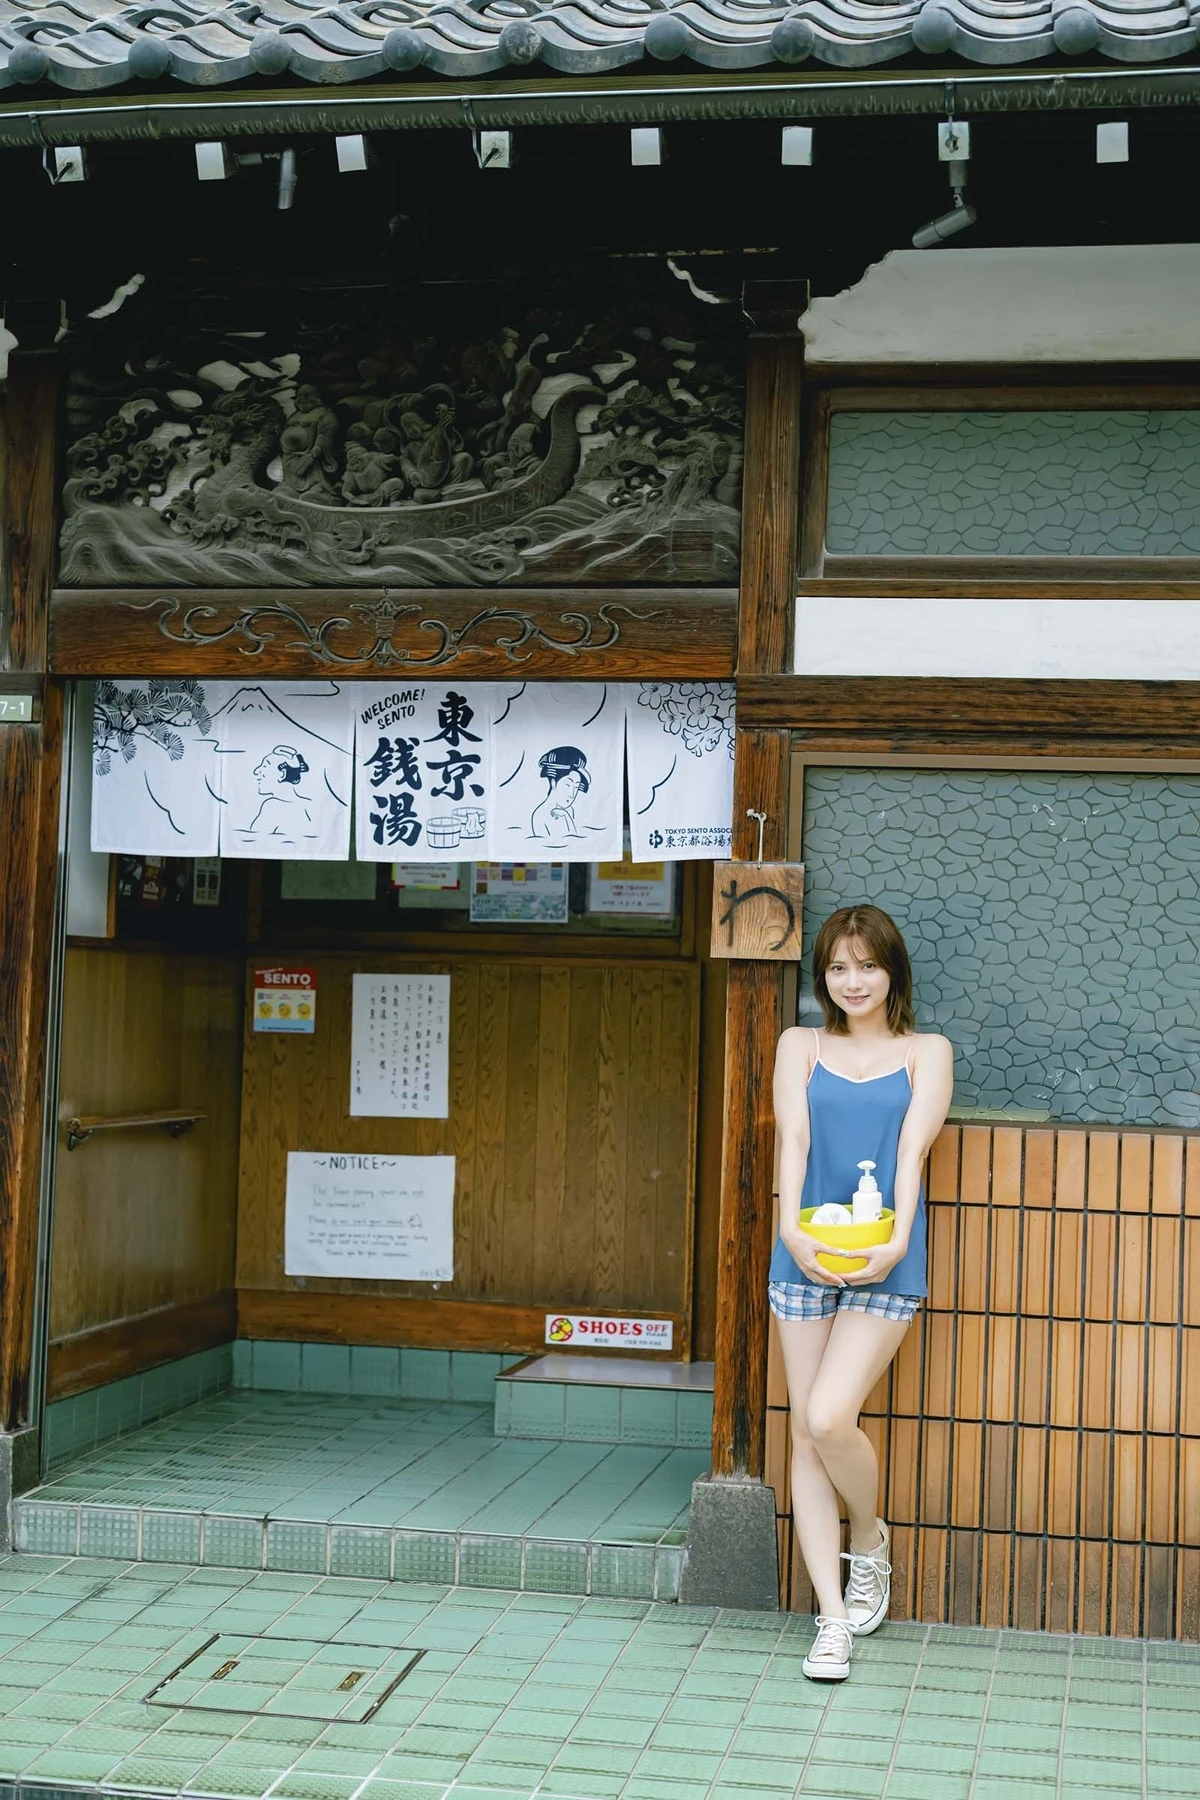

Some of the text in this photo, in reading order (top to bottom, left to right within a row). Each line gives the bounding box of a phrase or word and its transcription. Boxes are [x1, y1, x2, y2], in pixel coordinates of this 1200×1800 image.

[0, 700, 25, 716] 7-1
[361, 688, 426, 725] WELCOME!
[377, 704, 416, 730] SENTO
[423, 690, 485, 802] 東京
[363, 736, 423, 847] 銭湯
[719, 880, 795, 952] わ
[263, 972, 312, 986] SENTO
[577, 1320, 668, 1336] SHOES OFF
